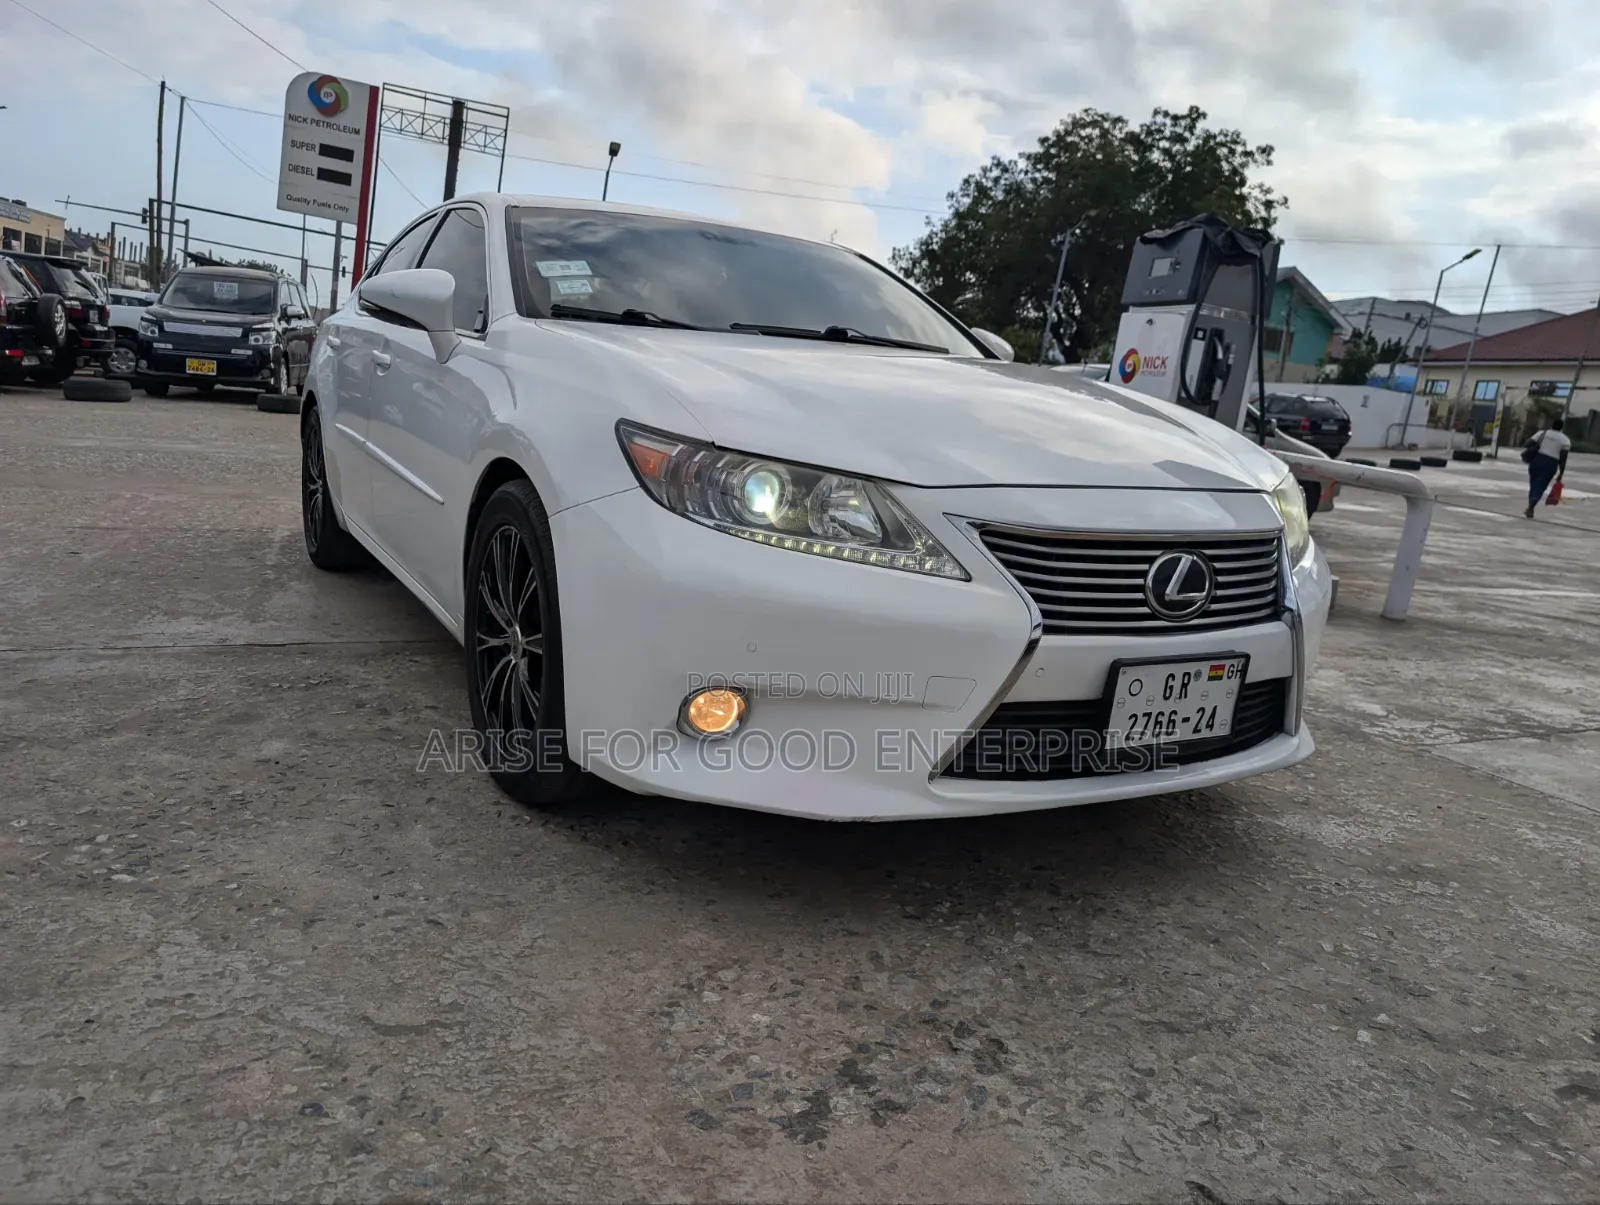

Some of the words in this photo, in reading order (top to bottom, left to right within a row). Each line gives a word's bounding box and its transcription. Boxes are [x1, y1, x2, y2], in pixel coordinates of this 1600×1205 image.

[288, 113, 308, 125] NICK
[310, 118, 361, 135] PETROLEUM
[290, 139, 316, 152] SUPER
[288, 163, 315, 177] DIESEL
[286, 194, 311, 206] Quality
[313, 199, 332, 209] Fuels
[333, 203, 350, 214] Only
[1142, 356, 1169, 369] NICK
[1162, 671, 1192, 701] GR
[1125, 705, 1218, 741] 2766-24
